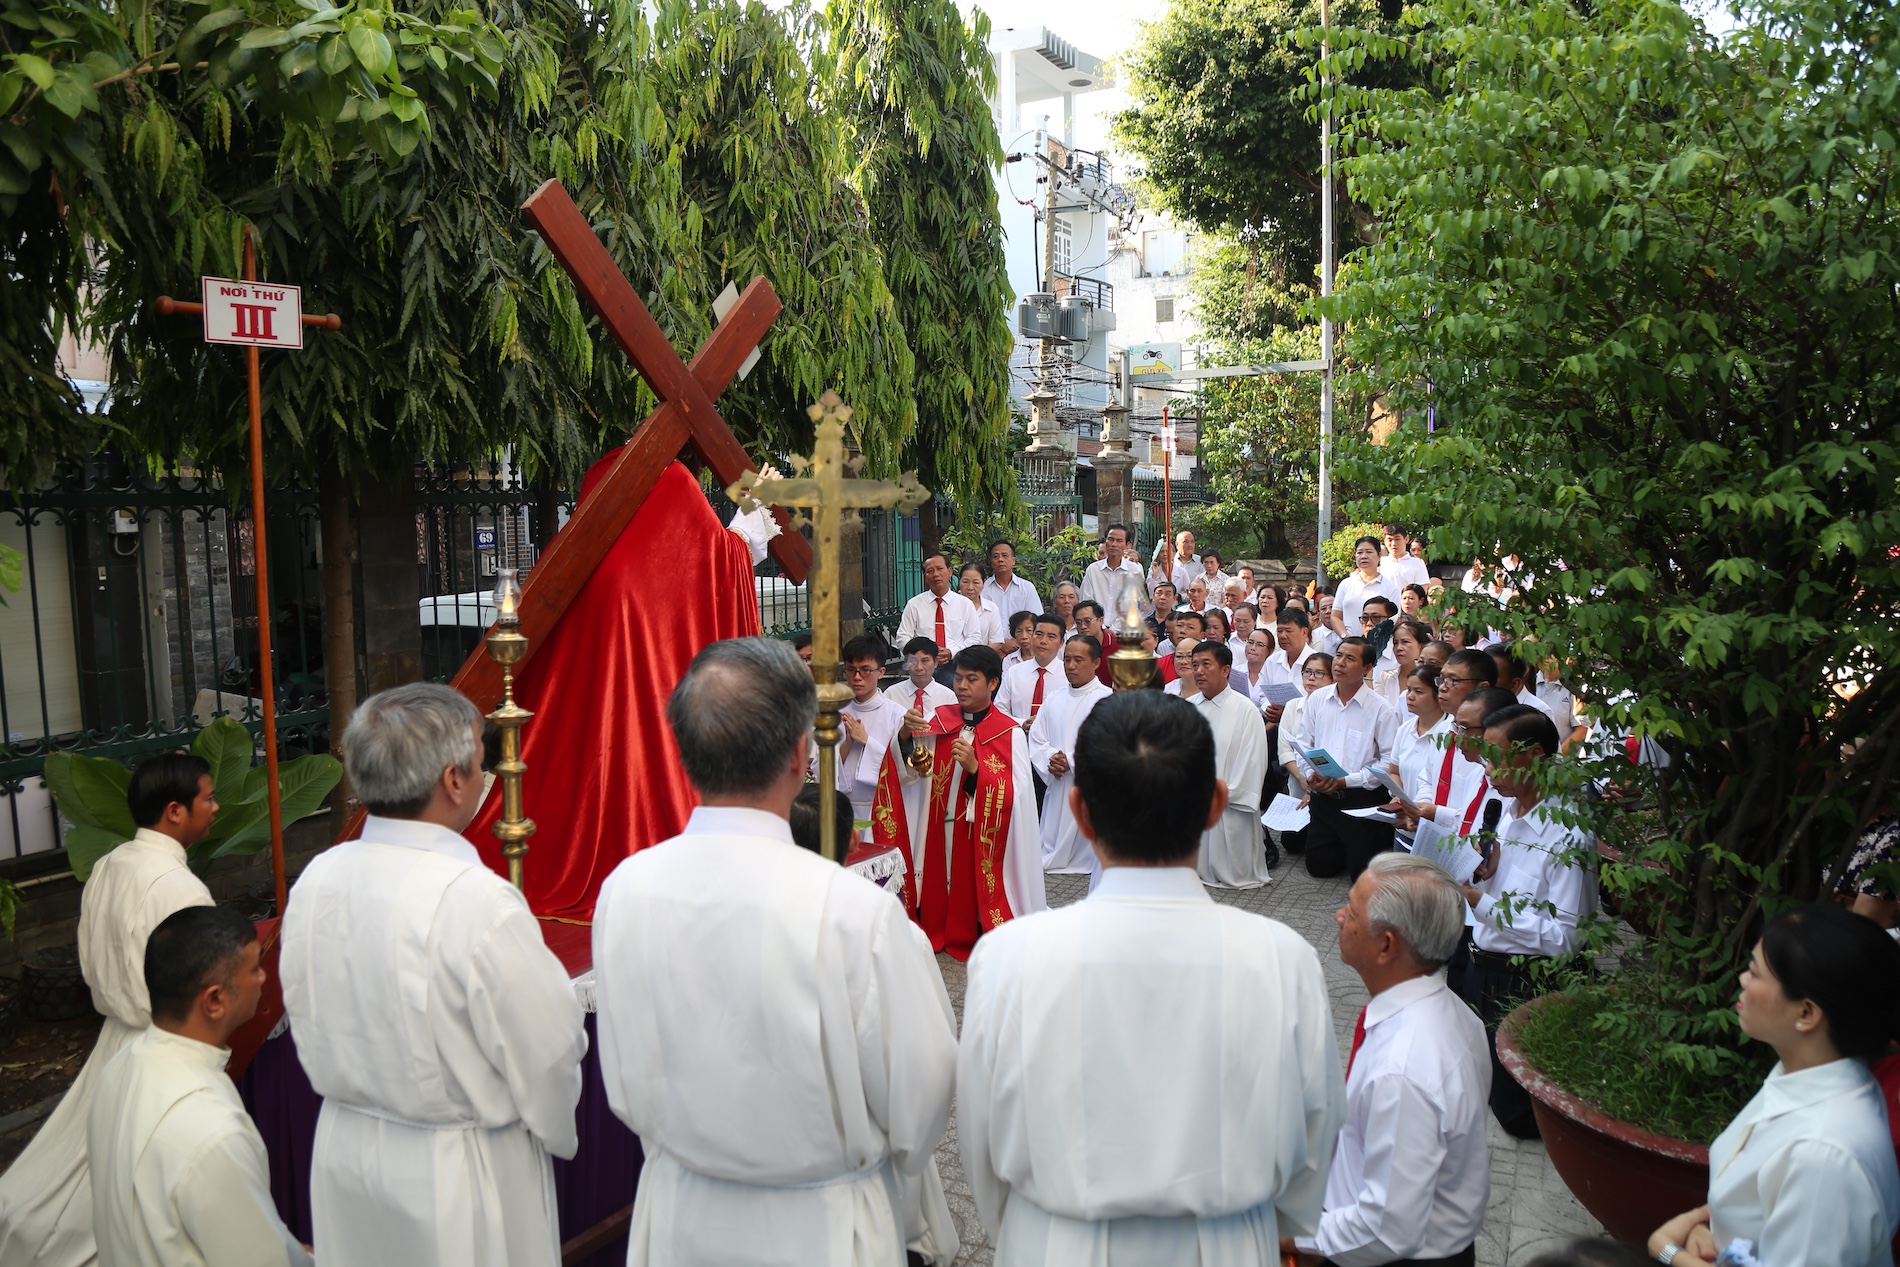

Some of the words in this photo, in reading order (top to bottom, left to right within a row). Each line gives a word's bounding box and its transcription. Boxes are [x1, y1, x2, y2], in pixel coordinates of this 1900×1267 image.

[221, 287, 247, 298] NƠI
[252, 290, 285, 301] THỨ
[230, 303, 278, 340] III
[479, 532, 493, 543] 69
